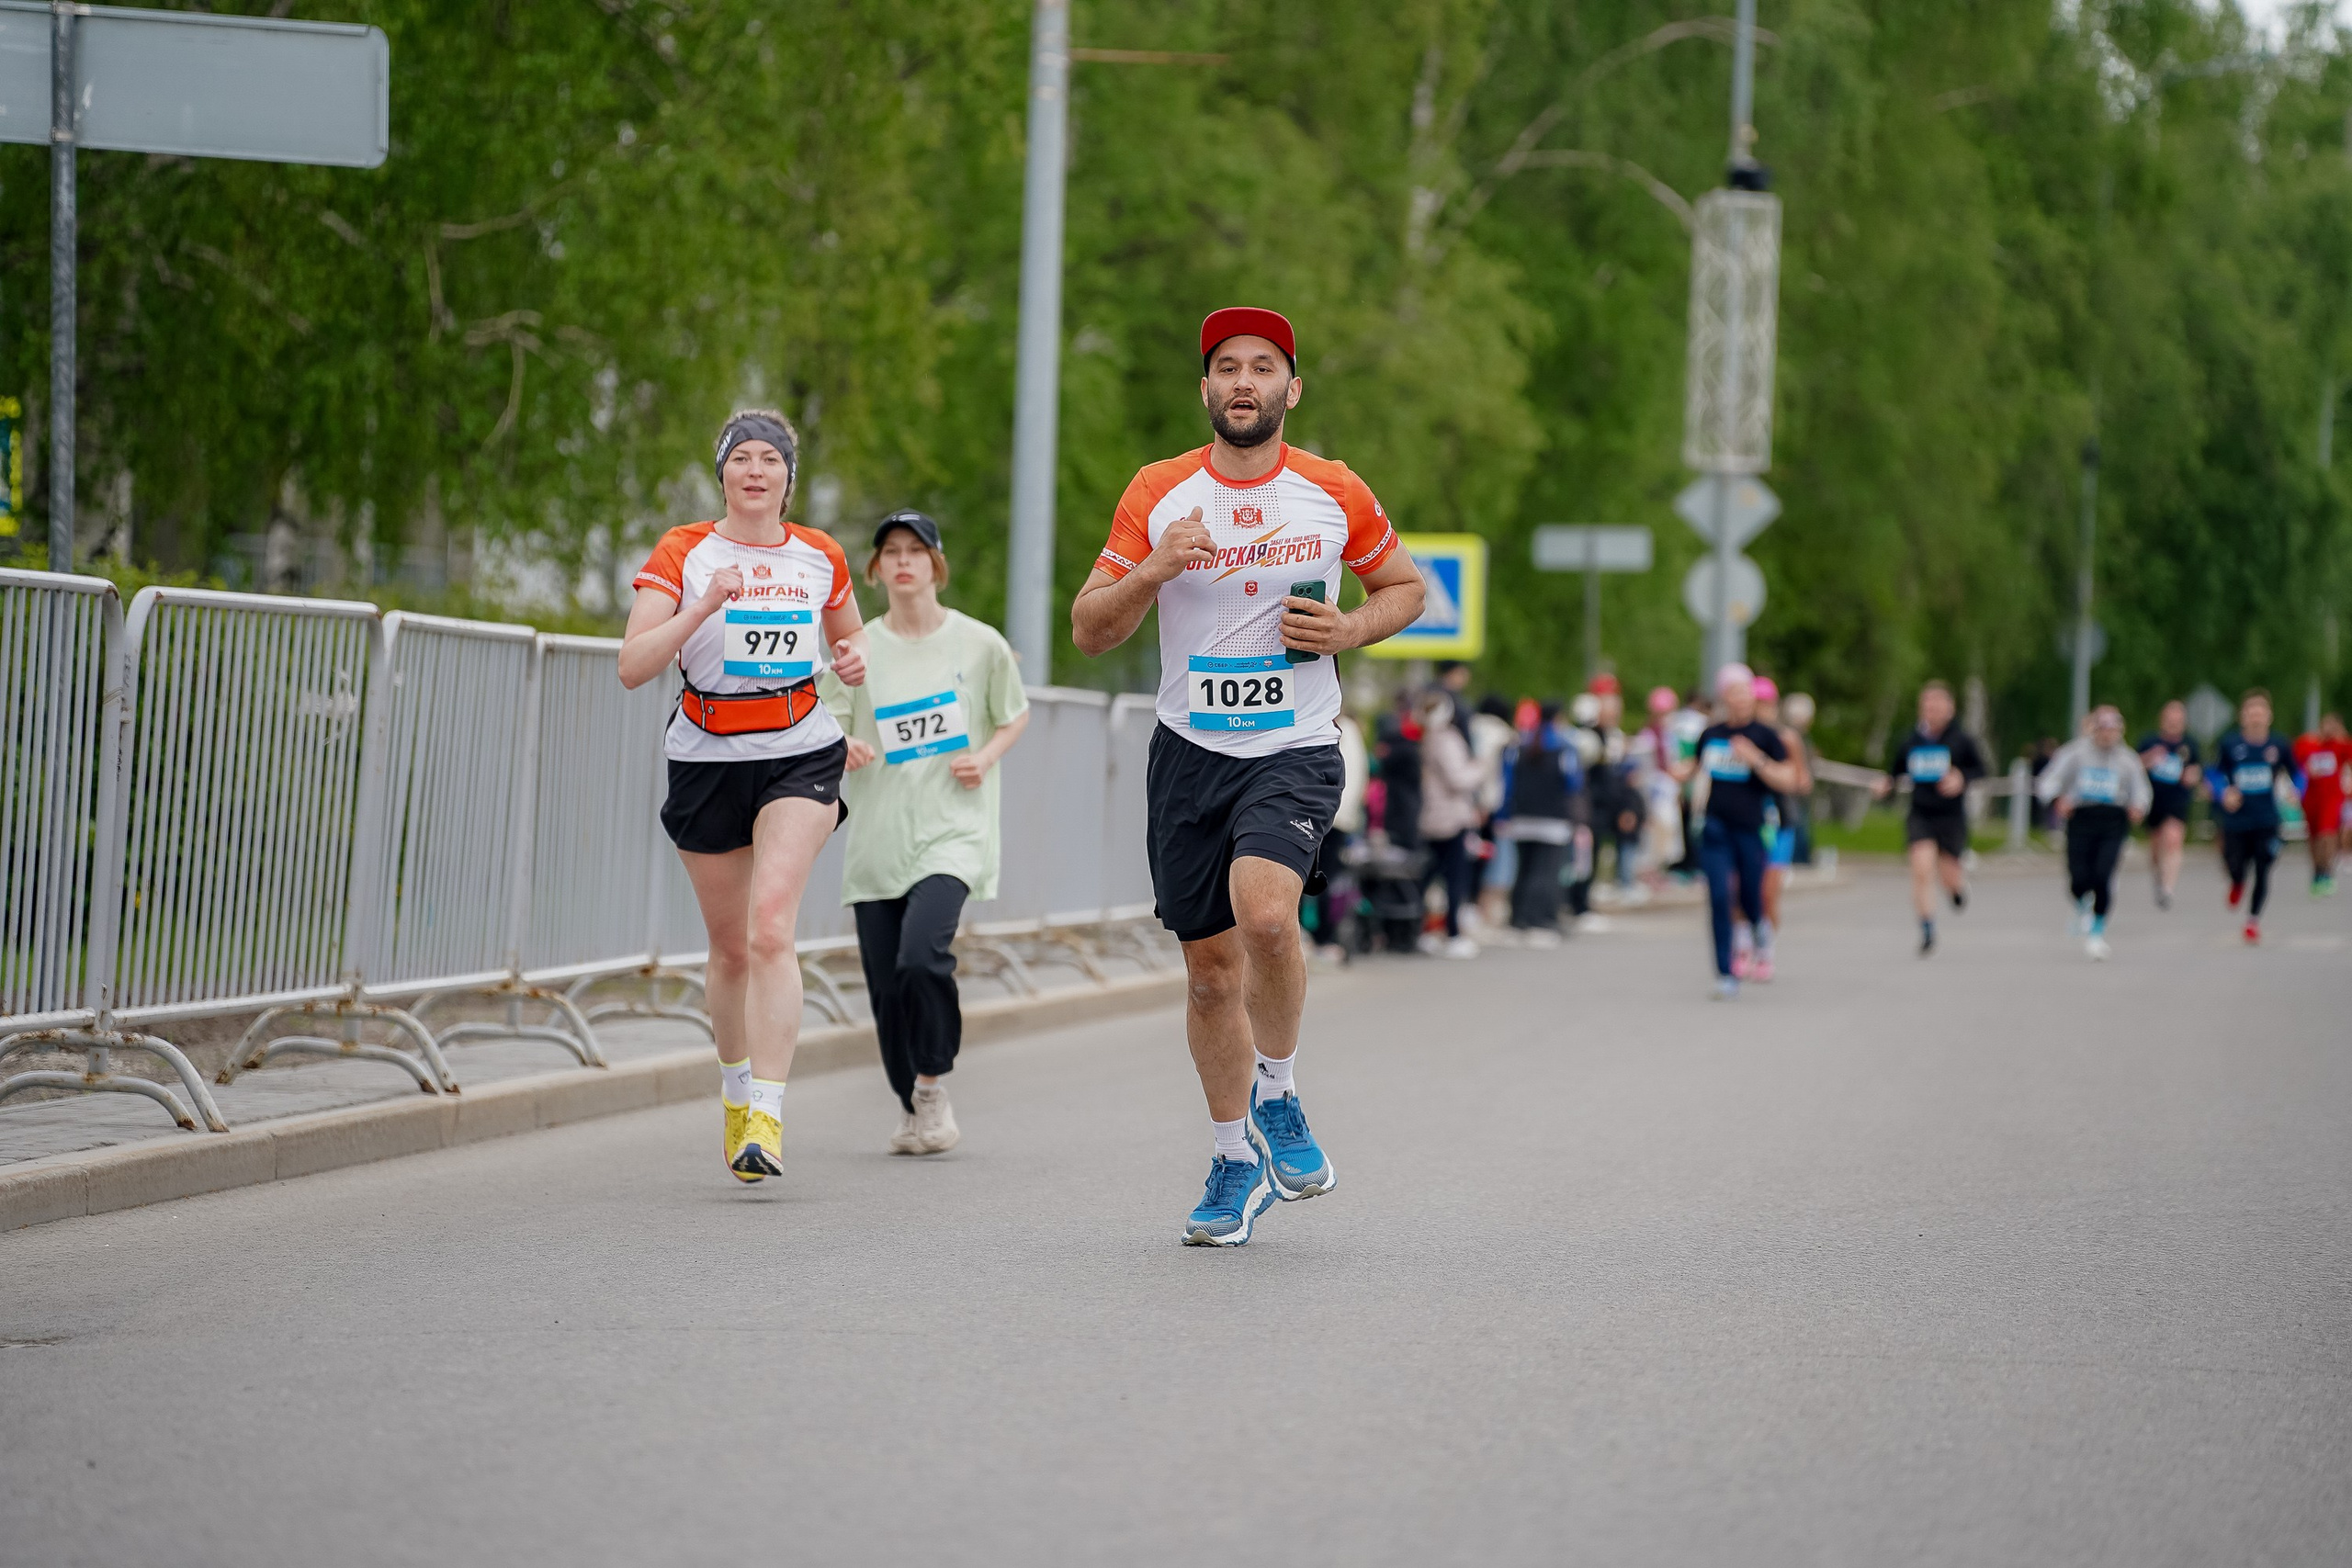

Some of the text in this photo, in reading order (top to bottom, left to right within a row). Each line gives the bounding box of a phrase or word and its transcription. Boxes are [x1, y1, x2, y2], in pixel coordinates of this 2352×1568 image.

[1264, 539, 1321, 567] ВЕРСТА
[1270, 537, 1284, 546] ЗАБЕГ
[740, 586, 808, 599] НЯГАНЬ
[744, 631, 797, 655] 979
[1201, 677, 1283, 707] 1028
[896, 713, 947, 742] 572
